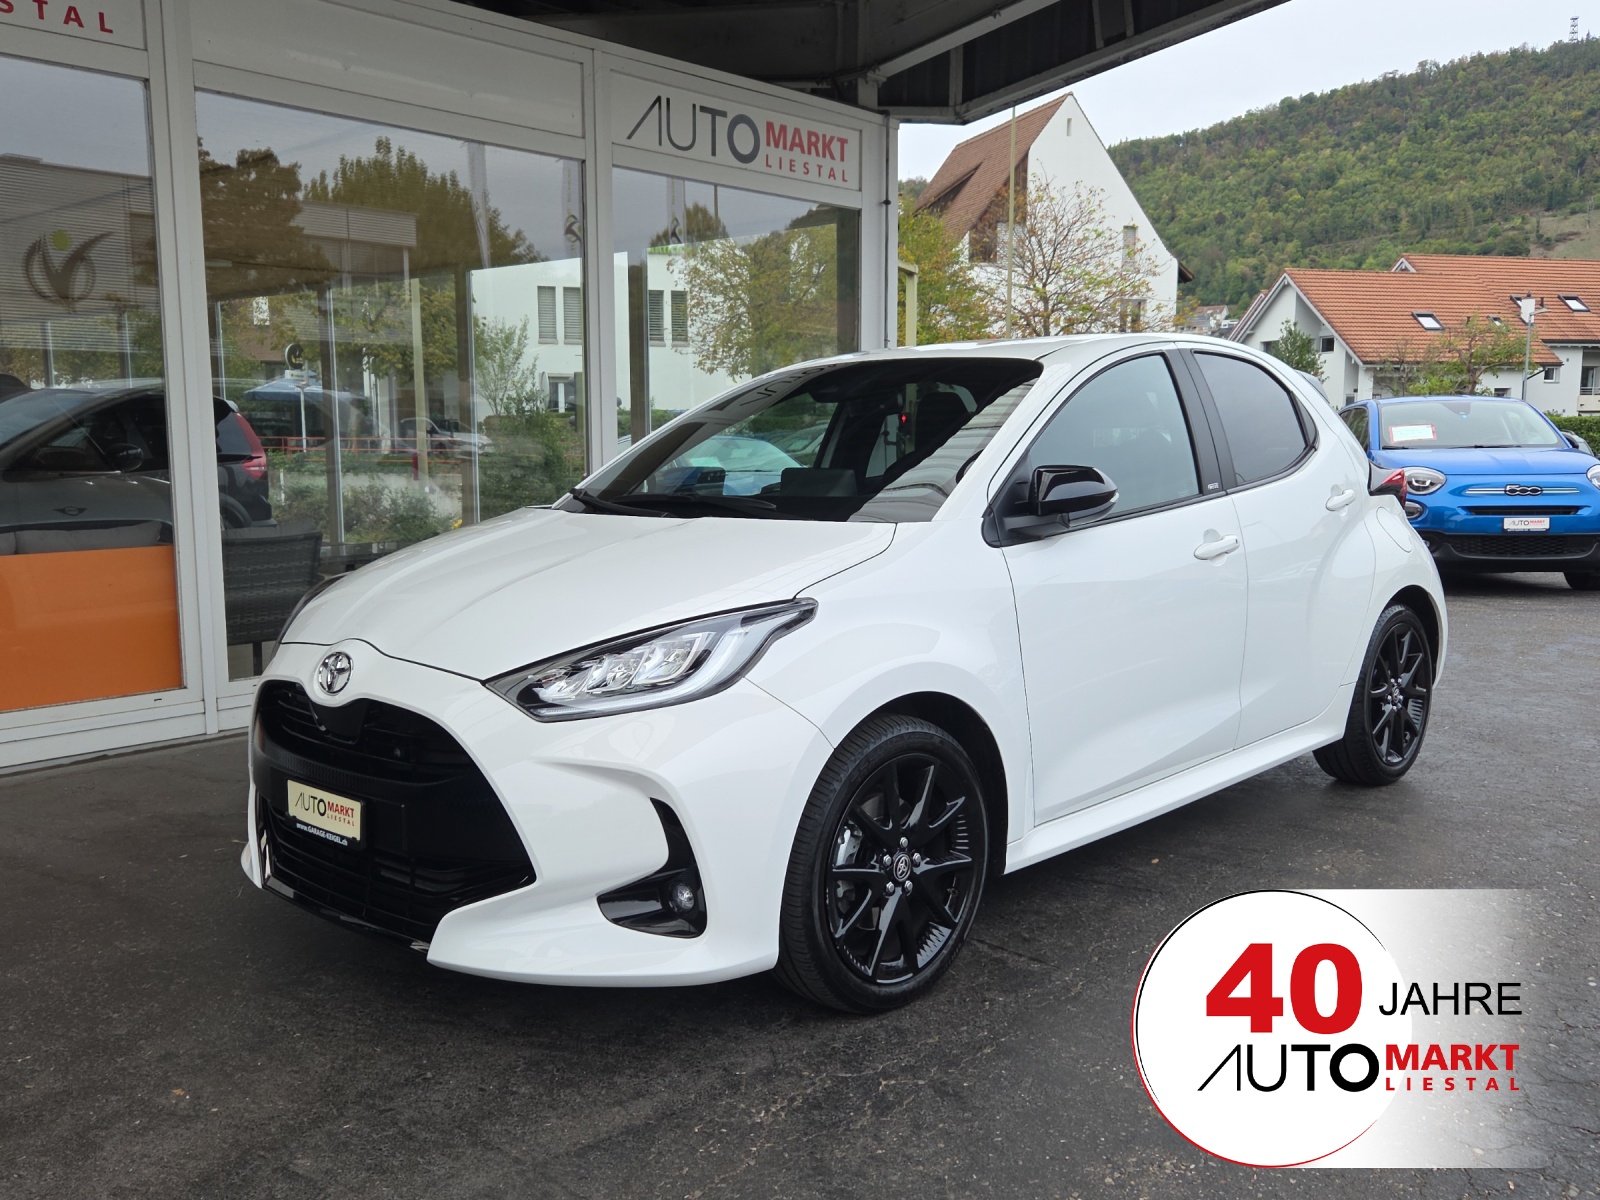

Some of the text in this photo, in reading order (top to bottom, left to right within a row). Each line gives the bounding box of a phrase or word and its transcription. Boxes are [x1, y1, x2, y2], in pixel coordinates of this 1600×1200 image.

[626, 95, 848, 164] AUTO MARKT
[765, 154, 848, 183] LIESTAL
[1505, 484, 1543, 496] 500
[295, 792, 355, 818] AUTO MARKT
[326, 813, 355, 827] LIESTAL
